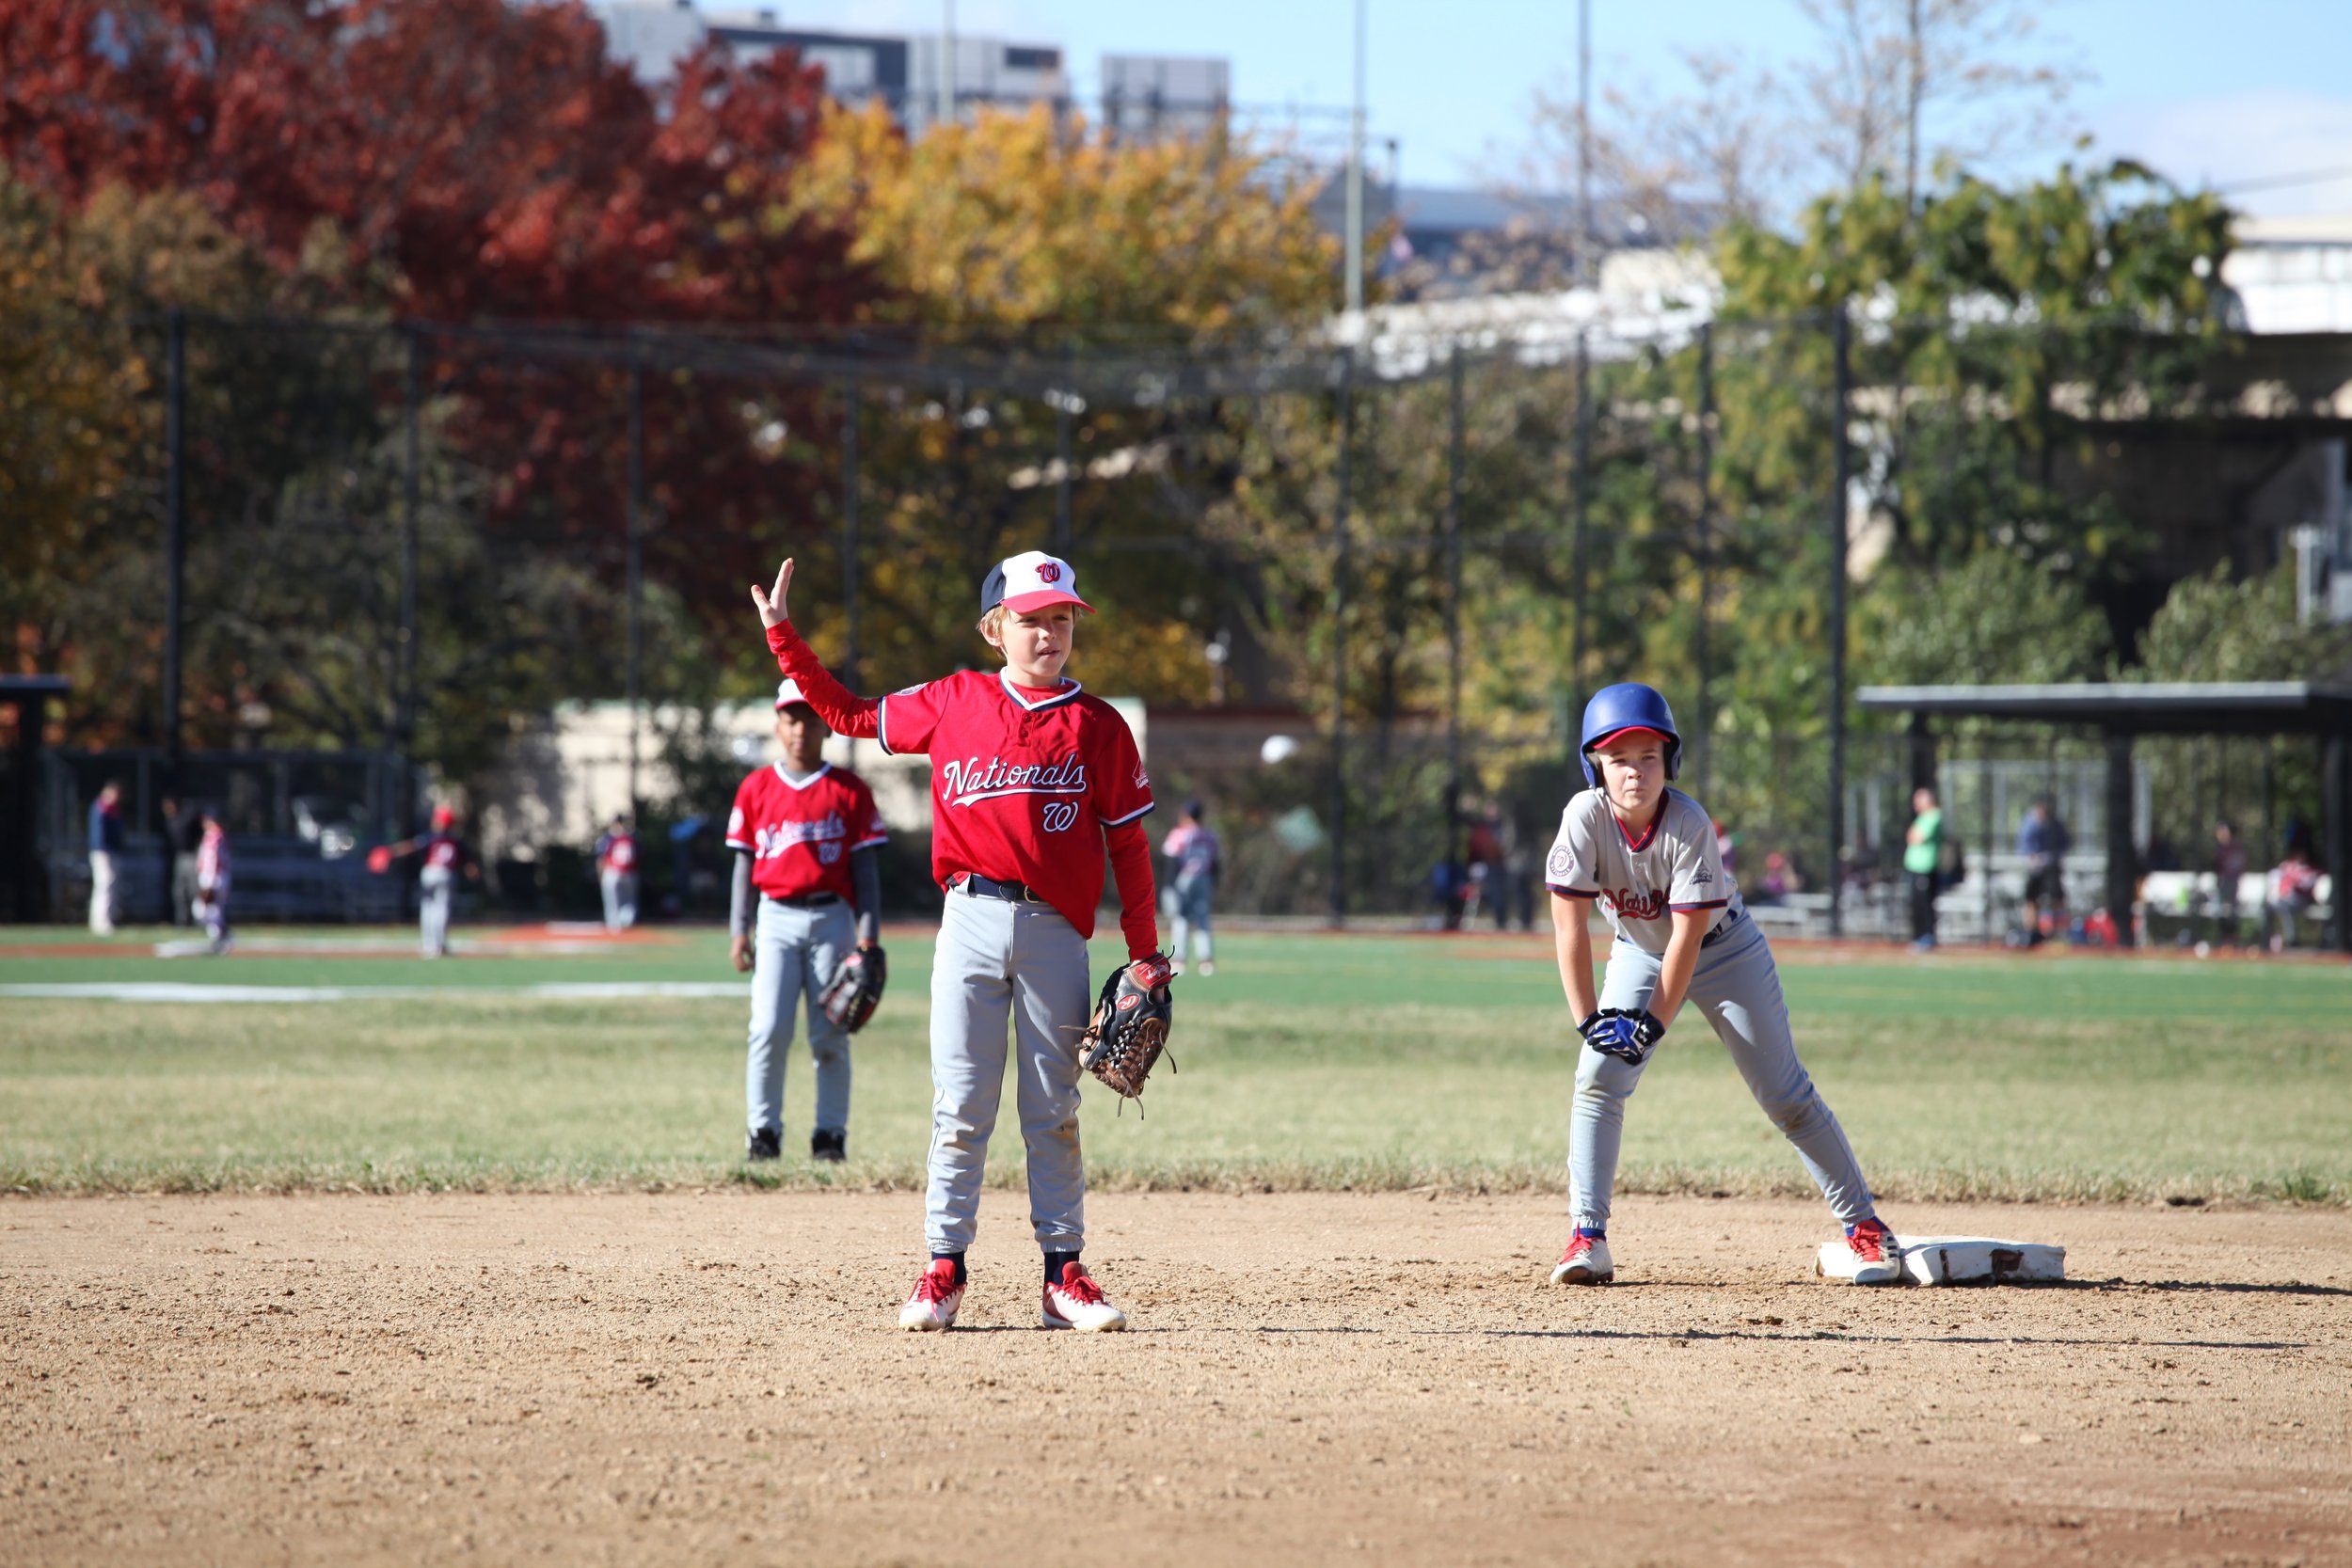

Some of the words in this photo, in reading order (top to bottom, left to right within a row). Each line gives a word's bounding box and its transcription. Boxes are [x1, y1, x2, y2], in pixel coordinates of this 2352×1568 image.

[1035, 562, 1061, 583] W
[943, 752, 1086, 801] Nationals
[1042, 801, 1079, 832] W
